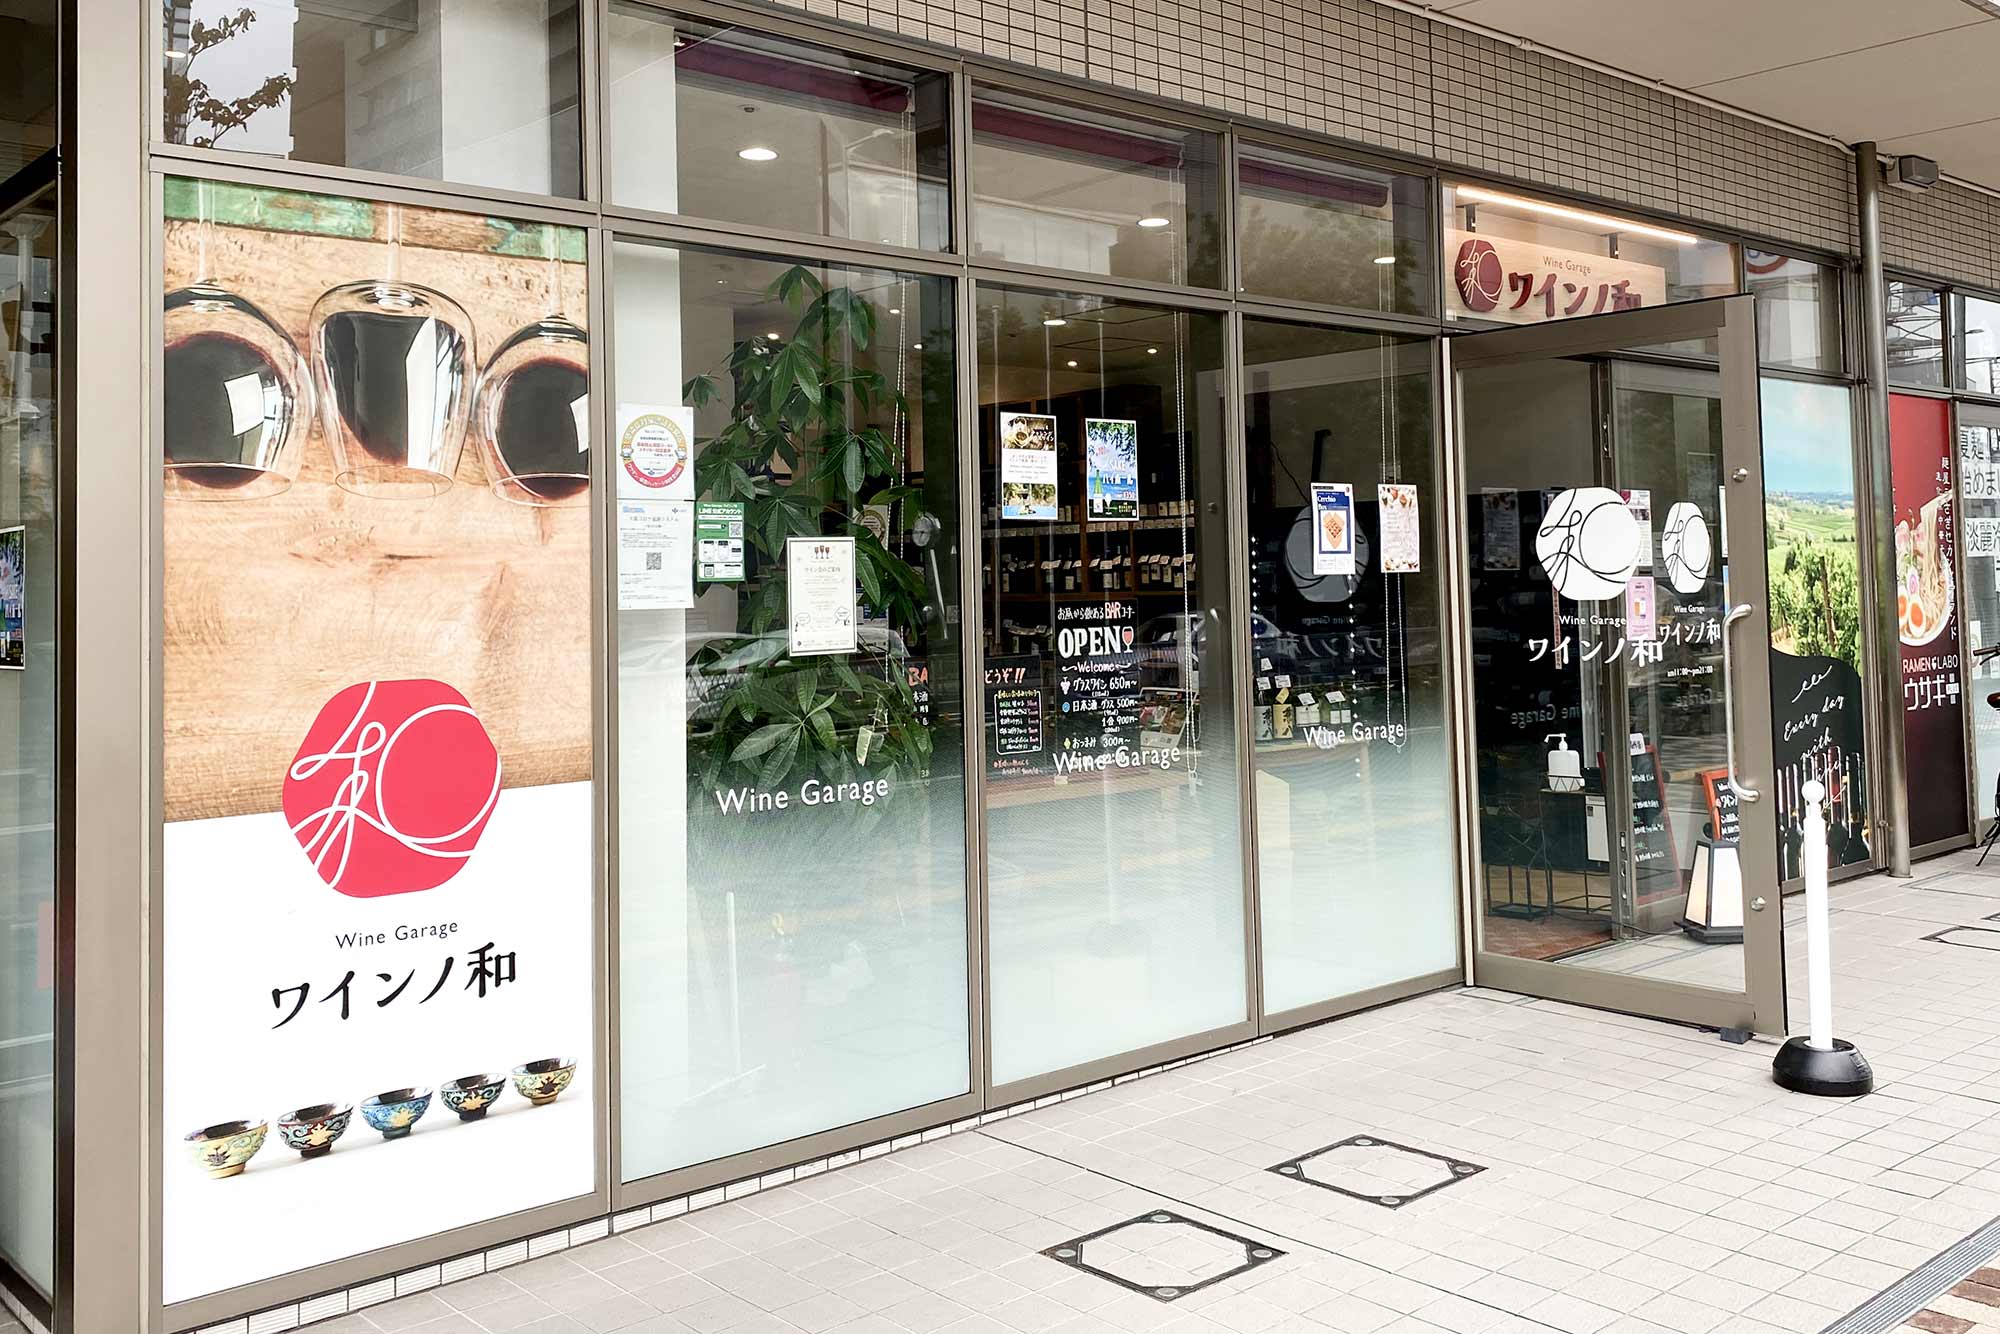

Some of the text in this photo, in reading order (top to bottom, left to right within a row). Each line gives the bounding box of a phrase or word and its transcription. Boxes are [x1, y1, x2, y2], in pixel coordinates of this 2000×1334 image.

[1543, 256, 1591, 276] Wine Garage
[1559, 615, 1626, 628] Wine Garage
[1673, 604, 1705, 614] Wine Garage
[1058, 625, 1121, 659] OPEN
[1658, 617, 1721, 646] ワインノ和
[1528, 634, 1664, 667] ワインノ和
[1902, 654, 1958, 674] RAMEN LABO
[1077, 661, 1115, 673] Welcome
[1073, 677, 1107, 691] グラスワイン
[1904, 674, 1946, 711] ウサギ
[1072, 699, 1098, 712] 日本酒
[1784, 695, 1845, 742] Every day
[1303, 721, 1404, 748] Wine Garage
[1800, 726, 1832, 760] with
[1052, 751, 1106, 775] Wine
[1115, 745, 1181, 770] Garage
[716, 778, 889, 816] Wine Garage
[335, 922, 459, 949] Wine Garage
[271, 941, 517, 1030] ワインノ和
